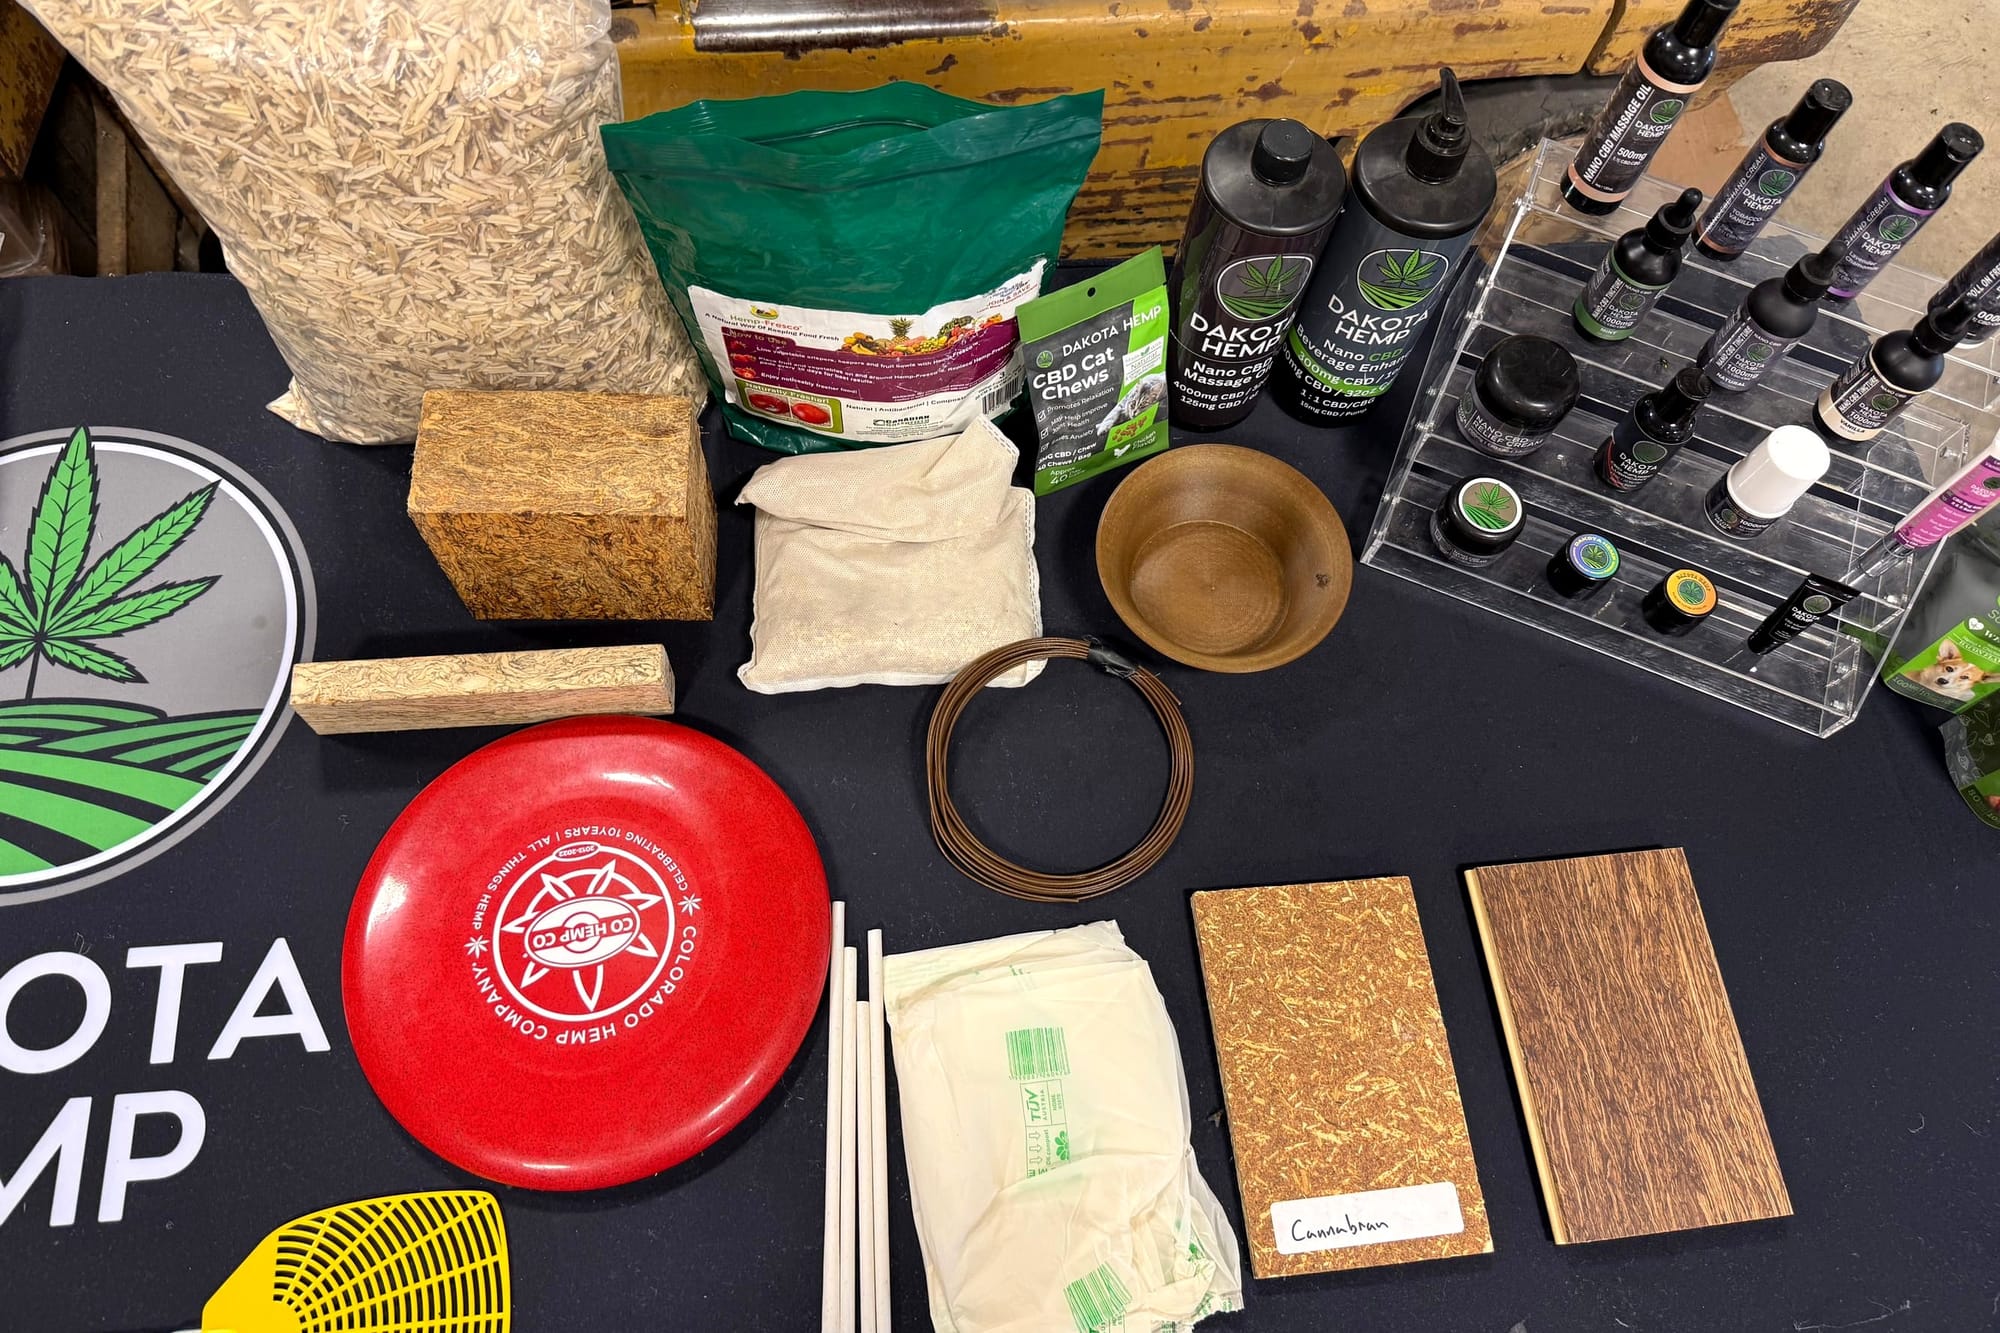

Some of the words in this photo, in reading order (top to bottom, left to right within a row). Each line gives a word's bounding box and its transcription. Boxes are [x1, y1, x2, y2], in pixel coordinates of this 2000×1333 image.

[1583, 157, 1603, 182] NANO
[1599, 138, 1614, 159] CBD
[1609, 98, 1641, 142] MASSAGE
[1637, 84, 1652, 101] OIL
[1634, 120, 1672, 132] DAKOTA
[1637, 129, 1665, 138] HEMP
[1617, 147, 1648, 161] 500mg
[1730, 178, 1747, 199] HAND
[1745, 153, 1766, 179] CREAM
[1742, 187, 1782, 206] DAKOTA
[1743, 198, 1774, 212] HEMP
[1729, 212, 1755, 227] VANILLA
[1732, 208, 1763, 222] TOBACCO
[1848, 221, 1867, 242] HAND
[1866, 197, 1889, 222] CREAM
[1861, 242, 1892, 256] HEMP
[1862, 231, 1901, 251] DAKOTA
[1980, 274, 1993, 287] ON
[1327, 293, 1429, 332] DAKOTA
[1609, 305, 1638, 315] DAKOTA
[712, 314, 739, 327] Natural
[739, 321, 756, 330] Way
[767, 327, 799, 337] Keeping
[818, 334, 840, 342] Fresh
[1189, 311, 1297, 343] DAKOTA
[1602, 315, 1634, 327] 1000mg
[729, 329, 752, 339] How
[767, 337, 787, 345] Use
[1063, 325, 1118, 357] DAKOTA
[1123, 305, 1161, 332] HEMP
[1334, 323, 1411, 346] HEMP
[773, 347, 806, 359] vegetable
[1201, 336, 1281, 358] HEMP
[1296, 323, 1355, 371] Beverage
[1323, 339, 1364, 361] Nano
[1369, 348, 1403, 362] CBD
[1033, 363, 1077, 390] CBD
[1081, 347, 1115, 372] Cat
[1193, 361, 1237, 376] Nano
[1240, 357, 1272, 375] CBD
[1298, 351, 1340, 385] 300mg
[1343, 376, 1375, 386] CBD
[1735, 354, 1765, 368] DAKOTA
[1736, 361, 1758, 371] HEMP
[806, 368, 822, 376] days
[834, 373, 849, 381] best
[1184, 368, 1252, 388] Massage
[1716, 372, 1745, 387] NATURAL
[1726, 364, 1759, 379] 1000mg
[745, 382, 789, 397] Naturally
[761, 372, 780, 381] Enjoy
[781, 376, 815, 388] noticeably
[816, 382, 839, 391] fresher
[1041, 368, 1109, 401] Chews
[1304, 375, 1332, 394] CBD
[1173, 380, 1218, 401] 4000mg
[1220, 391, 1244, 400] CBD
[846, 403, 873, 412] Natural
[879, 401, 925, 412] Antibacterial
[1047, 400, 1080, 413] Promotes
[1081, 387, 1114, 404] Relaxation
[1180, 395, 1216, 410] 125mg
[1218, 400, 1241, 409] CBD
[1322, 396, 1376, 409] CBD/CBG
[1064, 411, 1081, 420] Help
[1082, 402, 1108, 417] Improve
[1321, 409, 1339, 417] CBD
[1859, 402, 1888, 417] DAKOTA
[1067, 418, 1090, 427] Health
[1840, 419, 1865, 433] VANILLA
[1849, 412, 1881, 427] 1000mg
[1070, 428, 1094, 440] Anxiety
[1472, 421, 1506, 444] RELIEF
[1506, 438, 1544, 448] CREAM
[1475, 415, 1502, 437] NANO
[1504, 435, 1529, 443] CBD
[1054, 450, 1072, 459] CBD
[1077, 442, 1097, 454] Chew
[1047, 459, 1072, 467] Chews
[1078, 452, 1092, 461] Bag
[1619, 452, 1657, 470] DAKOTA
[1620, 461, 1648, 475] HEMP
[1050, 474, 1068, 485] 40
[1791, 606, 1820, 619] DAKOTA
[527, 834, 551, 852] ALL
[625, 832, 688, 891] CELEBRATING
[487, 852, 527, 892] THINGS
[473, 894, 492, 930] HEMP
[560, 921, 608, 943] HEMP
[611, 917, 634, 933] CO
[532, 931, 556, 946] CO
[624, 925, 697, 1028] COLORADO
[555, 1022, 617, 1045] HEMP
